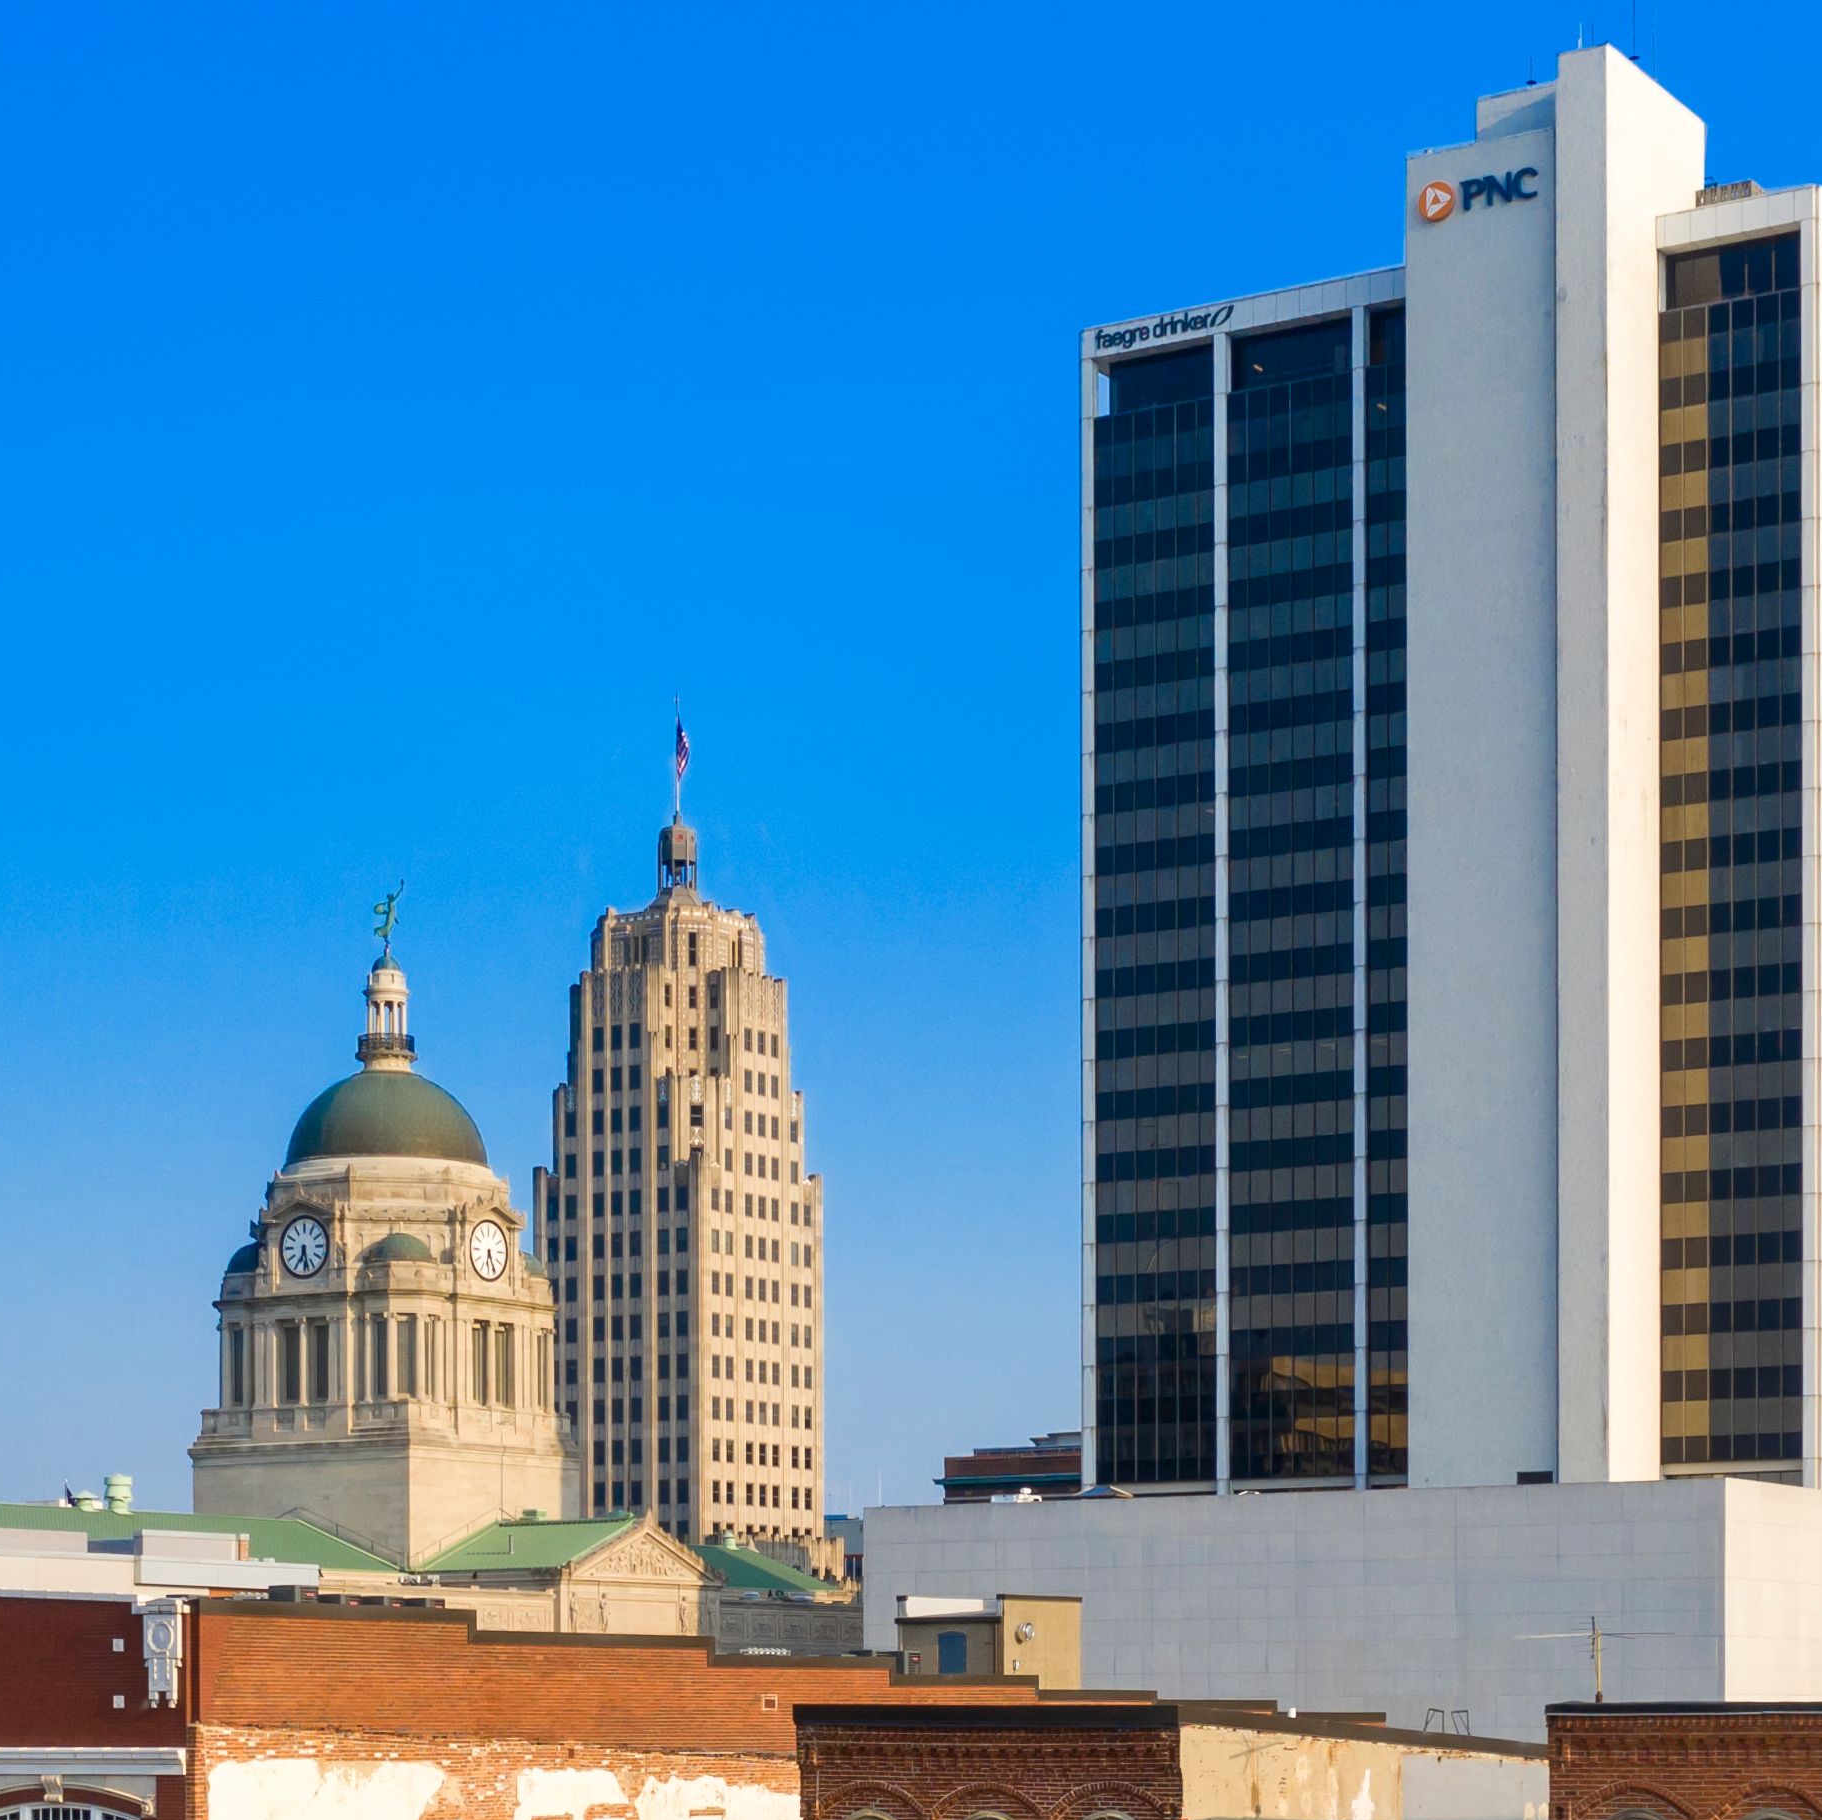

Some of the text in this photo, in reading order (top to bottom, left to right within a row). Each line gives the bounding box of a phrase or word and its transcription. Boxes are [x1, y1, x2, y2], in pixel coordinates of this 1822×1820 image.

[1459, 167, 1538, 211] PNC
[1095, 312, 1211, 349] faegre drinker
